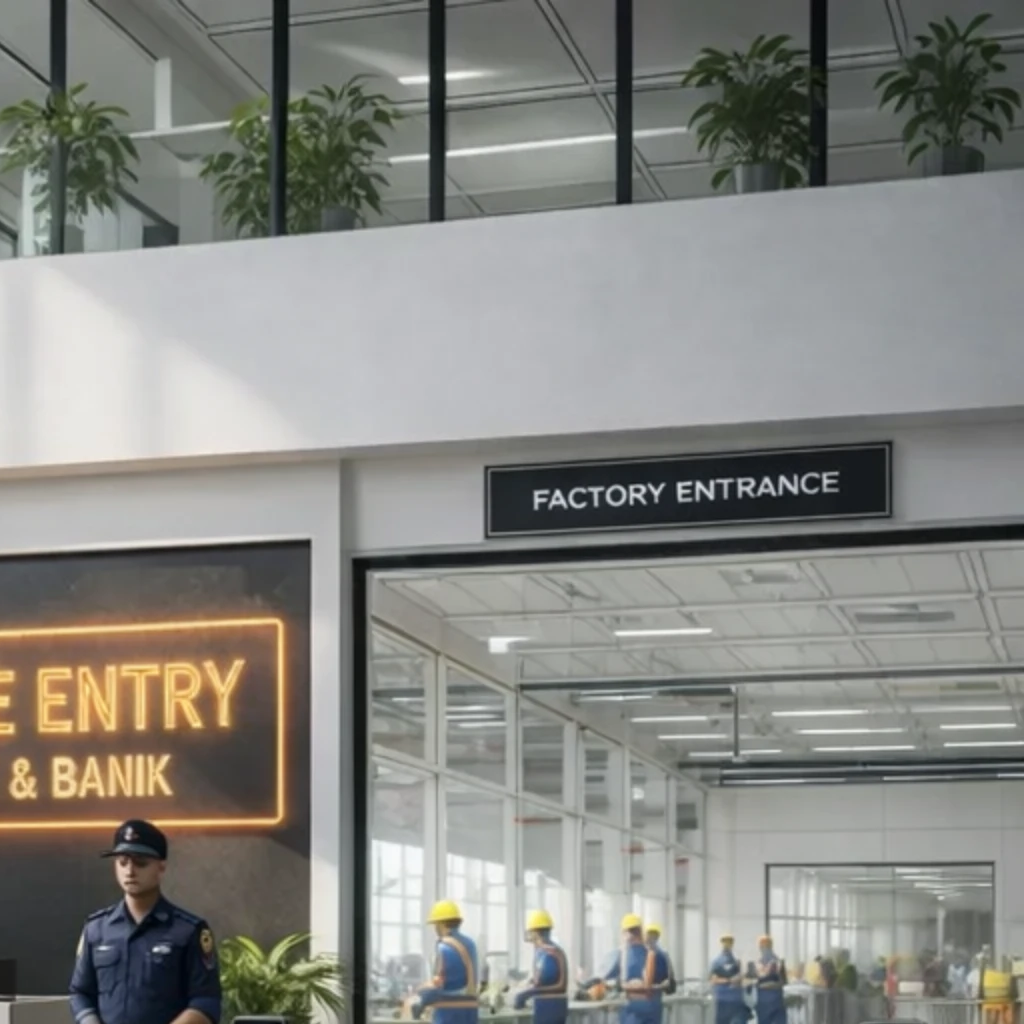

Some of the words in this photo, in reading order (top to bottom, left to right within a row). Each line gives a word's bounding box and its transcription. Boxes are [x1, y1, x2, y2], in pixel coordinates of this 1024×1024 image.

[533, 483, 666, 511] FACTORY
[676, 471, 840, 503] ENTRANCE
[36, 659, 246, 734] ENTRY
[9, 757, 37, 800] &
[51, 753, 174, 799] BANIK
